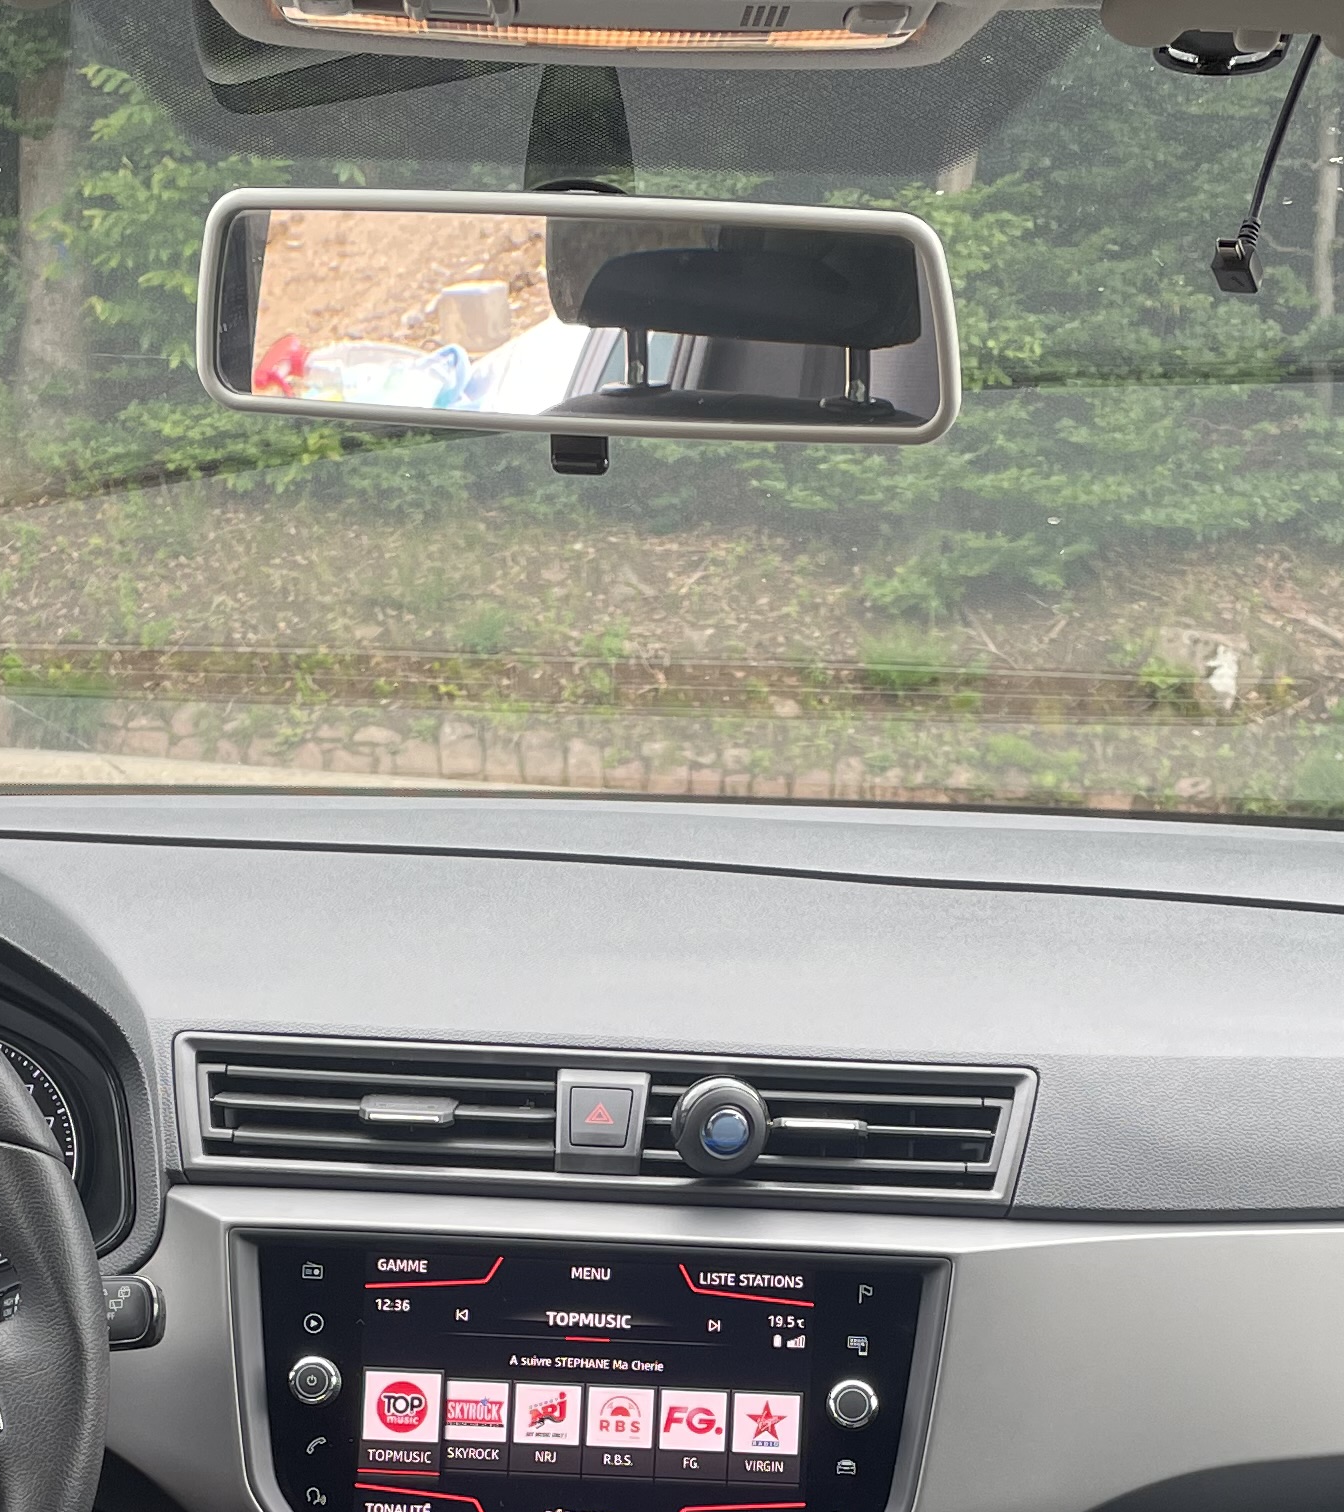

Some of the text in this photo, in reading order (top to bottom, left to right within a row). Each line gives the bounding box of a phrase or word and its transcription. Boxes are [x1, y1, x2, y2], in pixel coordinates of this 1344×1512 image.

[377, 1258, 428, 1273] GAMME
[571, 1266, 612, 1281] MENU
[699, 1271, 804, 1289] LISTE STATIONS
[545, 1311, 632, 1329] TOPMUSIC
[509, 1354, 664, 1372] A suivre STEPHANE Ma Cherie
[382, 1393, 425, 1414] TOP
[447, 1399, 501, 1421] SKYROCK
[386, 1413, 419, 1425] music
[663, 1406, 723, 1435] FG.
[367, 1448, 432, 1464] TOPMUSIC
[447, 1447, 500, 1460] SKYROCK
[534, 1450, 557, 1463] NRJ
[745, 1459, 784, 1473] VIRGIN
